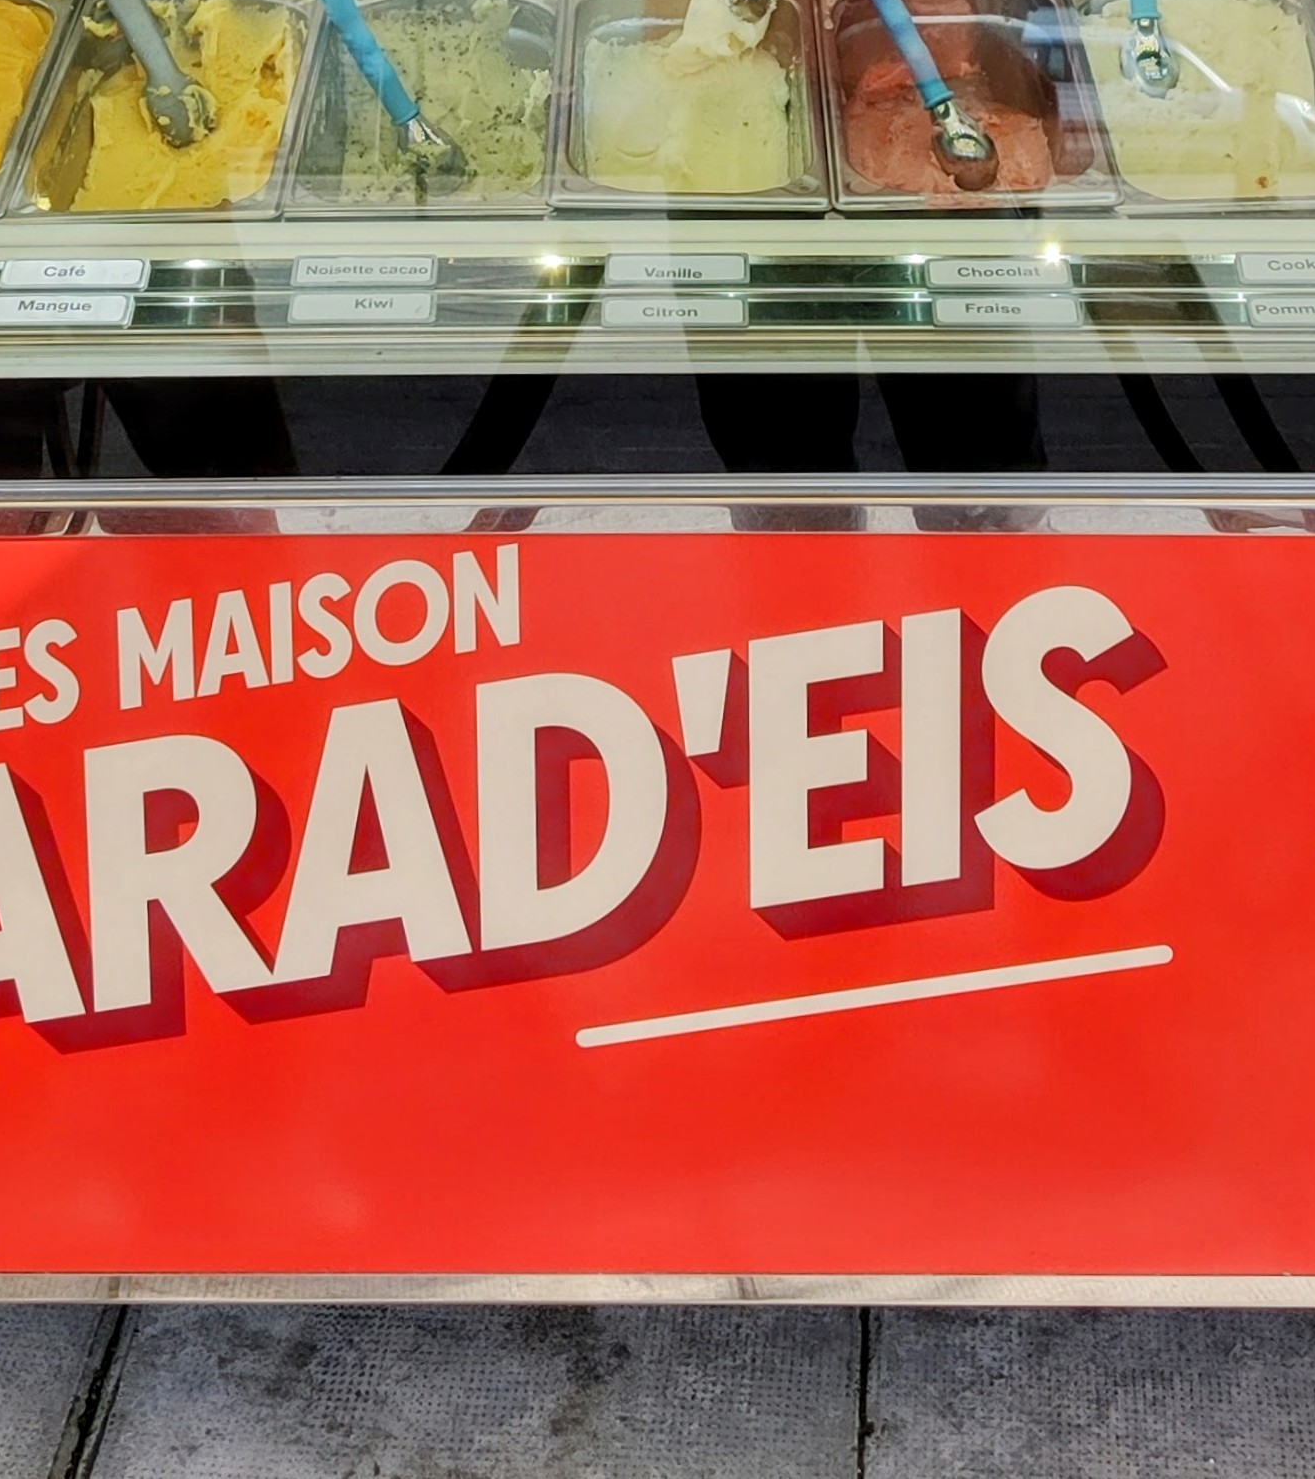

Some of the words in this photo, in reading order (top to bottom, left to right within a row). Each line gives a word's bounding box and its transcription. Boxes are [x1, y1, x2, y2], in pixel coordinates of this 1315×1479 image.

[43, 264, 86, 279] Café
[305, 263, 375, 277] Noisette
[379, 264, 429, 277] cacao
[643, 266, 703, 280] Vanille
[957, 264, 1041, 279] Chocolat
[17, 299, 92, 315] Mangue
[353, 296, 394, 310] Kiwi
[964, 302, 1022, 316] Fraise
[641, 304, 699, 319] Citron
[117, 542, 522, 710] MAISON
